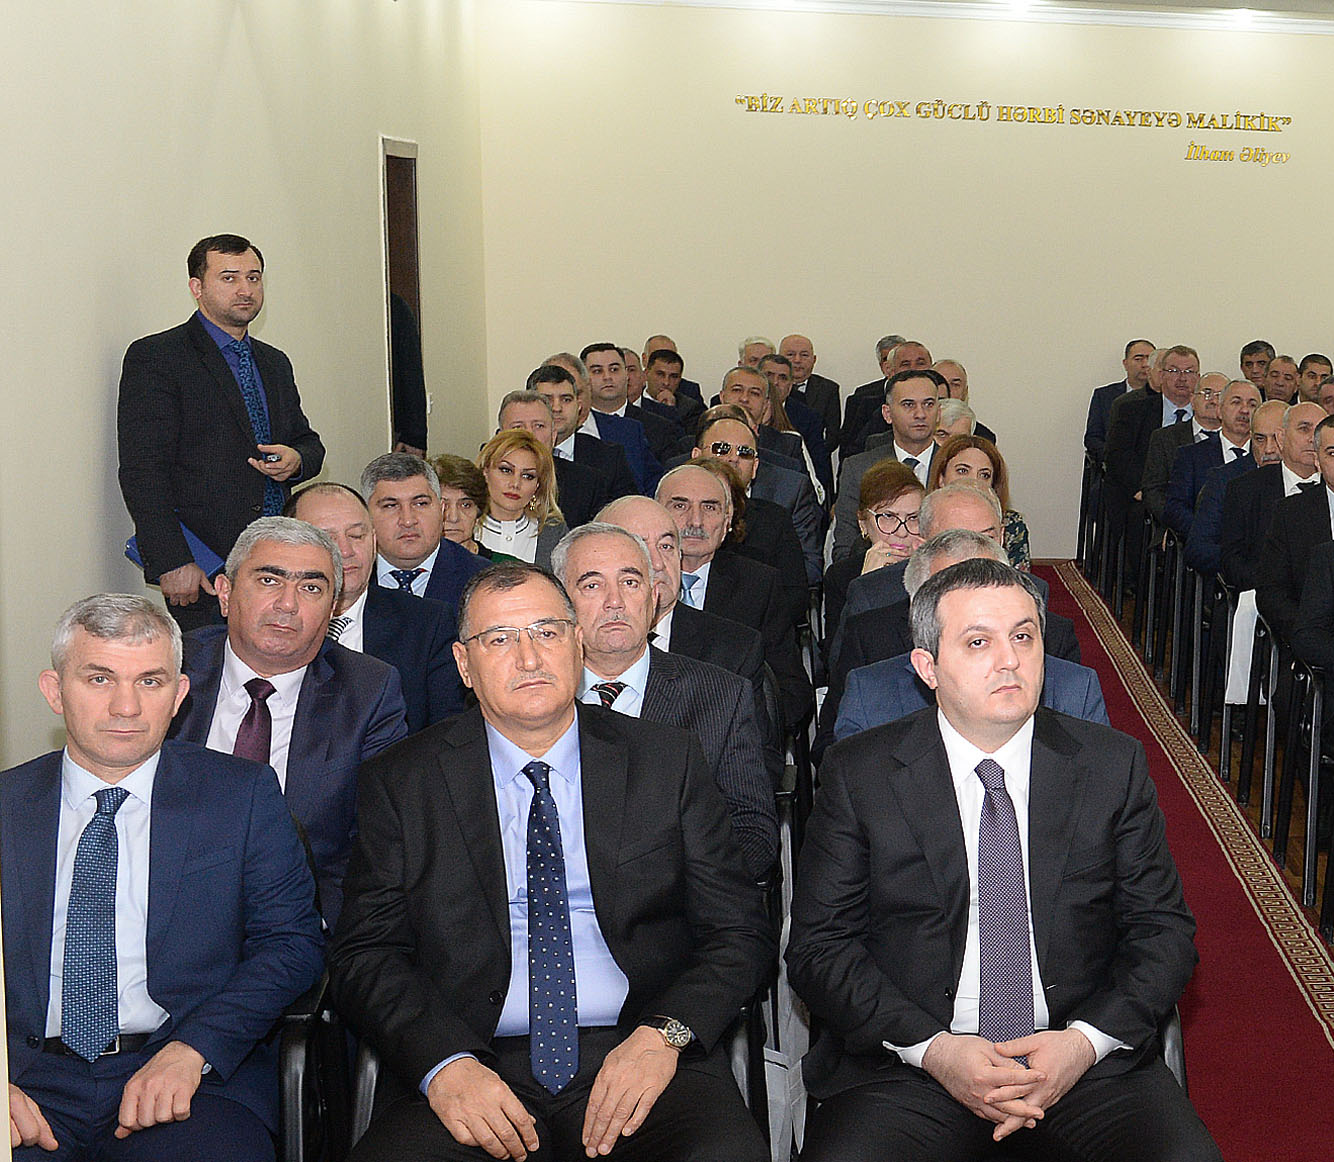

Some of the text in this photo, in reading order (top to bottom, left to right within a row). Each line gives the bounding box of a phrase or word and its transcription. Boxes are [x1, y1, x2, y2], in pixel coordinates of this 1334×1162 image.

[863, 99, 911, 120] ÇOX
[915, 98, 991, 121] GÜCLÜ
[996, 103, 1065, 125] HƏRBİ
[1070, 108, 1182, 128] SƏNAYEYƏ
[1184, 141, 1291, 167] İlham Əliyev
